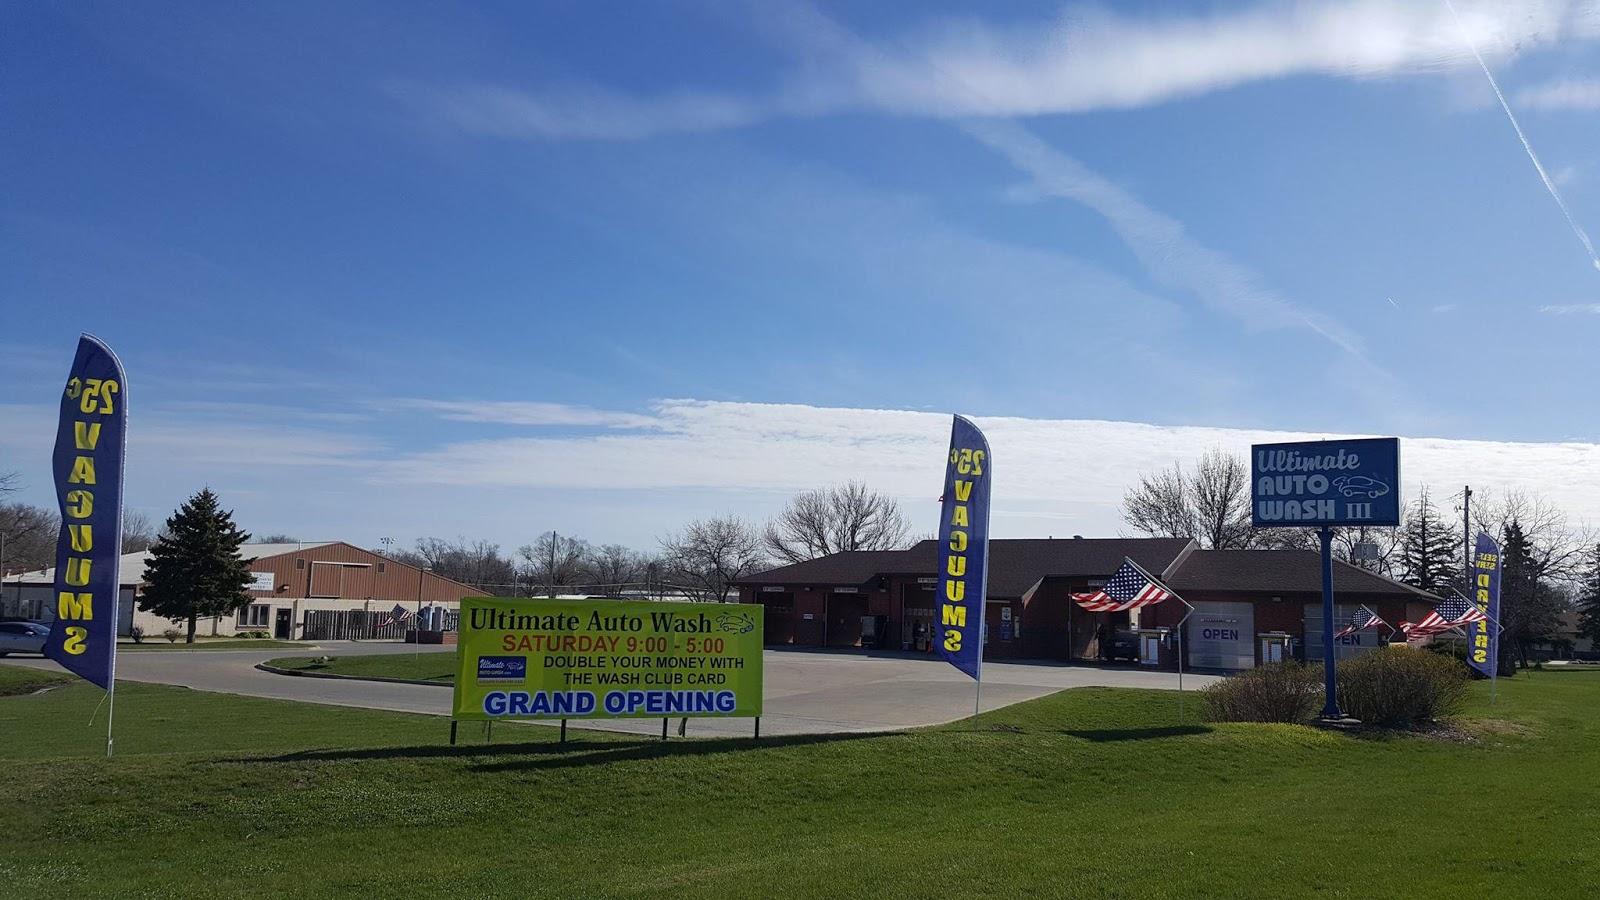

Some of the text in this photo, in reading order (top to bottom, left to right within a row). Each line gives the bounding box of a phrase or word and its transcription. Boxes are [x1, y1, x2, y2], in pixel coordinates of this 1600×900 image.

[1258, 449, 1361, 473] Ultimate
[1258, 474, 1330, 496] AUTO
[1259, 500, 1373, 520] WASH III
[470, 607, 712, 633] Ultimate Auto Wash
[502, 634, 621, 652] SATURDAY
[627, 636, 667, 653] 9:00
[687, 637, 725, 653] 5:00
[1202, 628, 1239, 640] OPEN
[1321, 634, 1361, 646] EN
[544, 656, 744, 669] DOUBLE YOUR MONEY WITH
[564, 673, 726, 685] THE WASH CLUB CARD
[483, 690, 736, 715] GRAND OPENING
